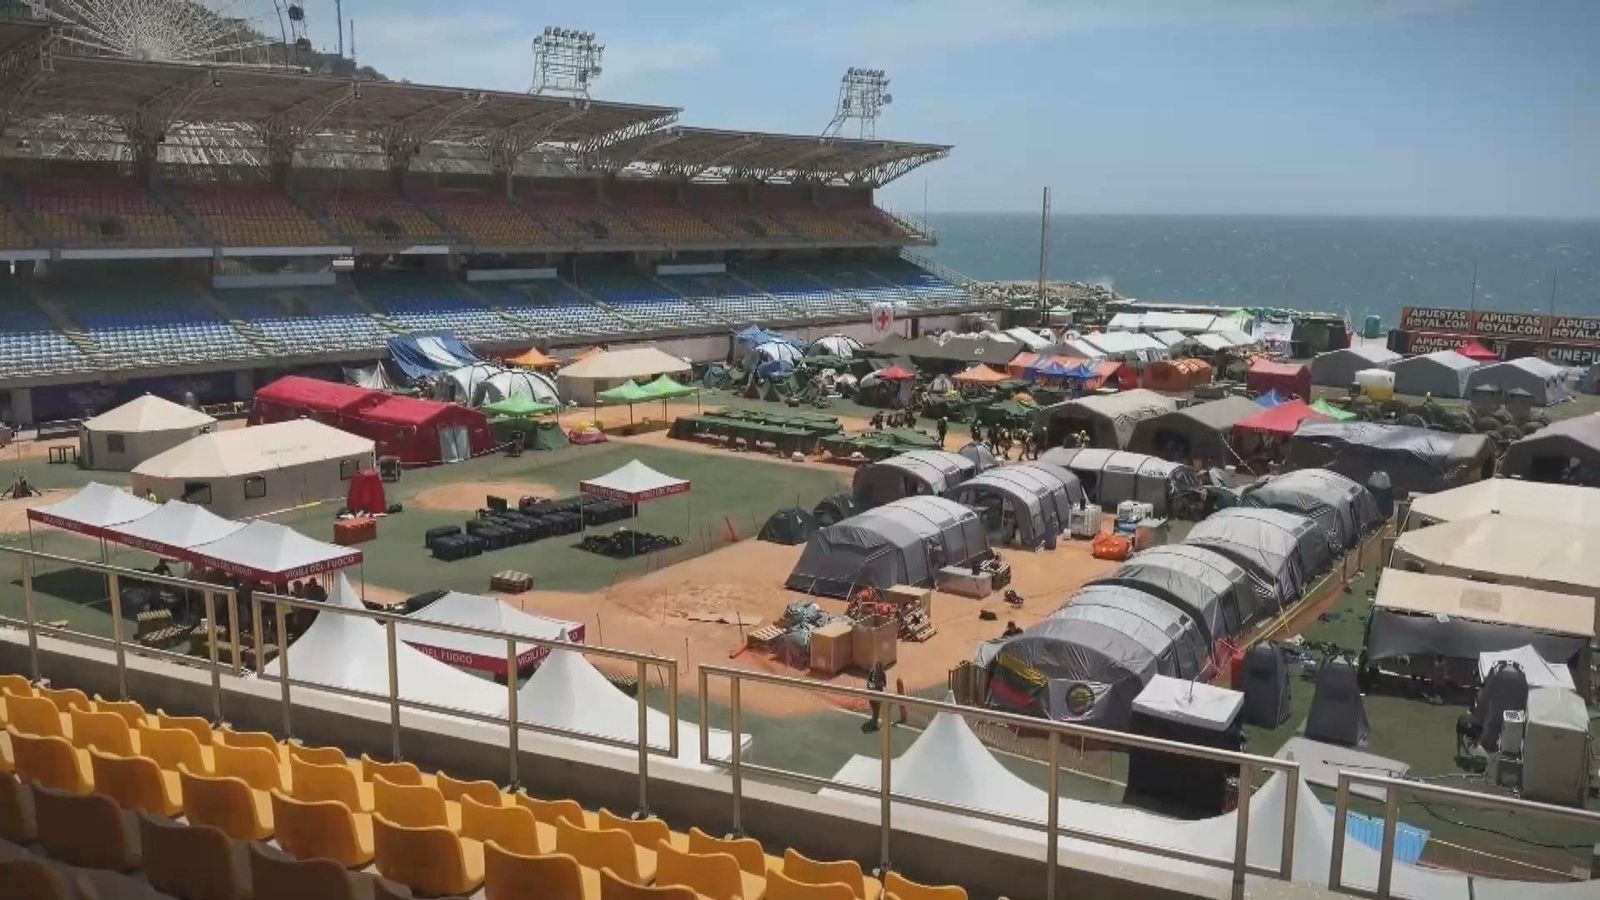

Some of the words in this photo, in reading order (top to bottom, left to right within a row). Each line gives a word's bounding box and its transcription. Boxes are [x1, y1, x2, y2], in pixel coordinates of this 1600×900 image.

[1411, 308, 1466, 320] APUESTAS
[1481, 313, 1541, 327] APUESTAS
[1406, 317, 1469, 329] ROYAL.COM
[1476, 321, 1544, 335] ROYAL.COM
[1551, 328, 1600, 340] ROYAL.C
[1415, 336, 1468, 348] APUESTAS
[310, 563, 325, 573] DEL
[327, 555, 354, 569] FUOCO
[422, 647, 439, 660] DEL
[441, 650, 473, 665] FUOCO
[518, 650, 539, 665] VIGILI
